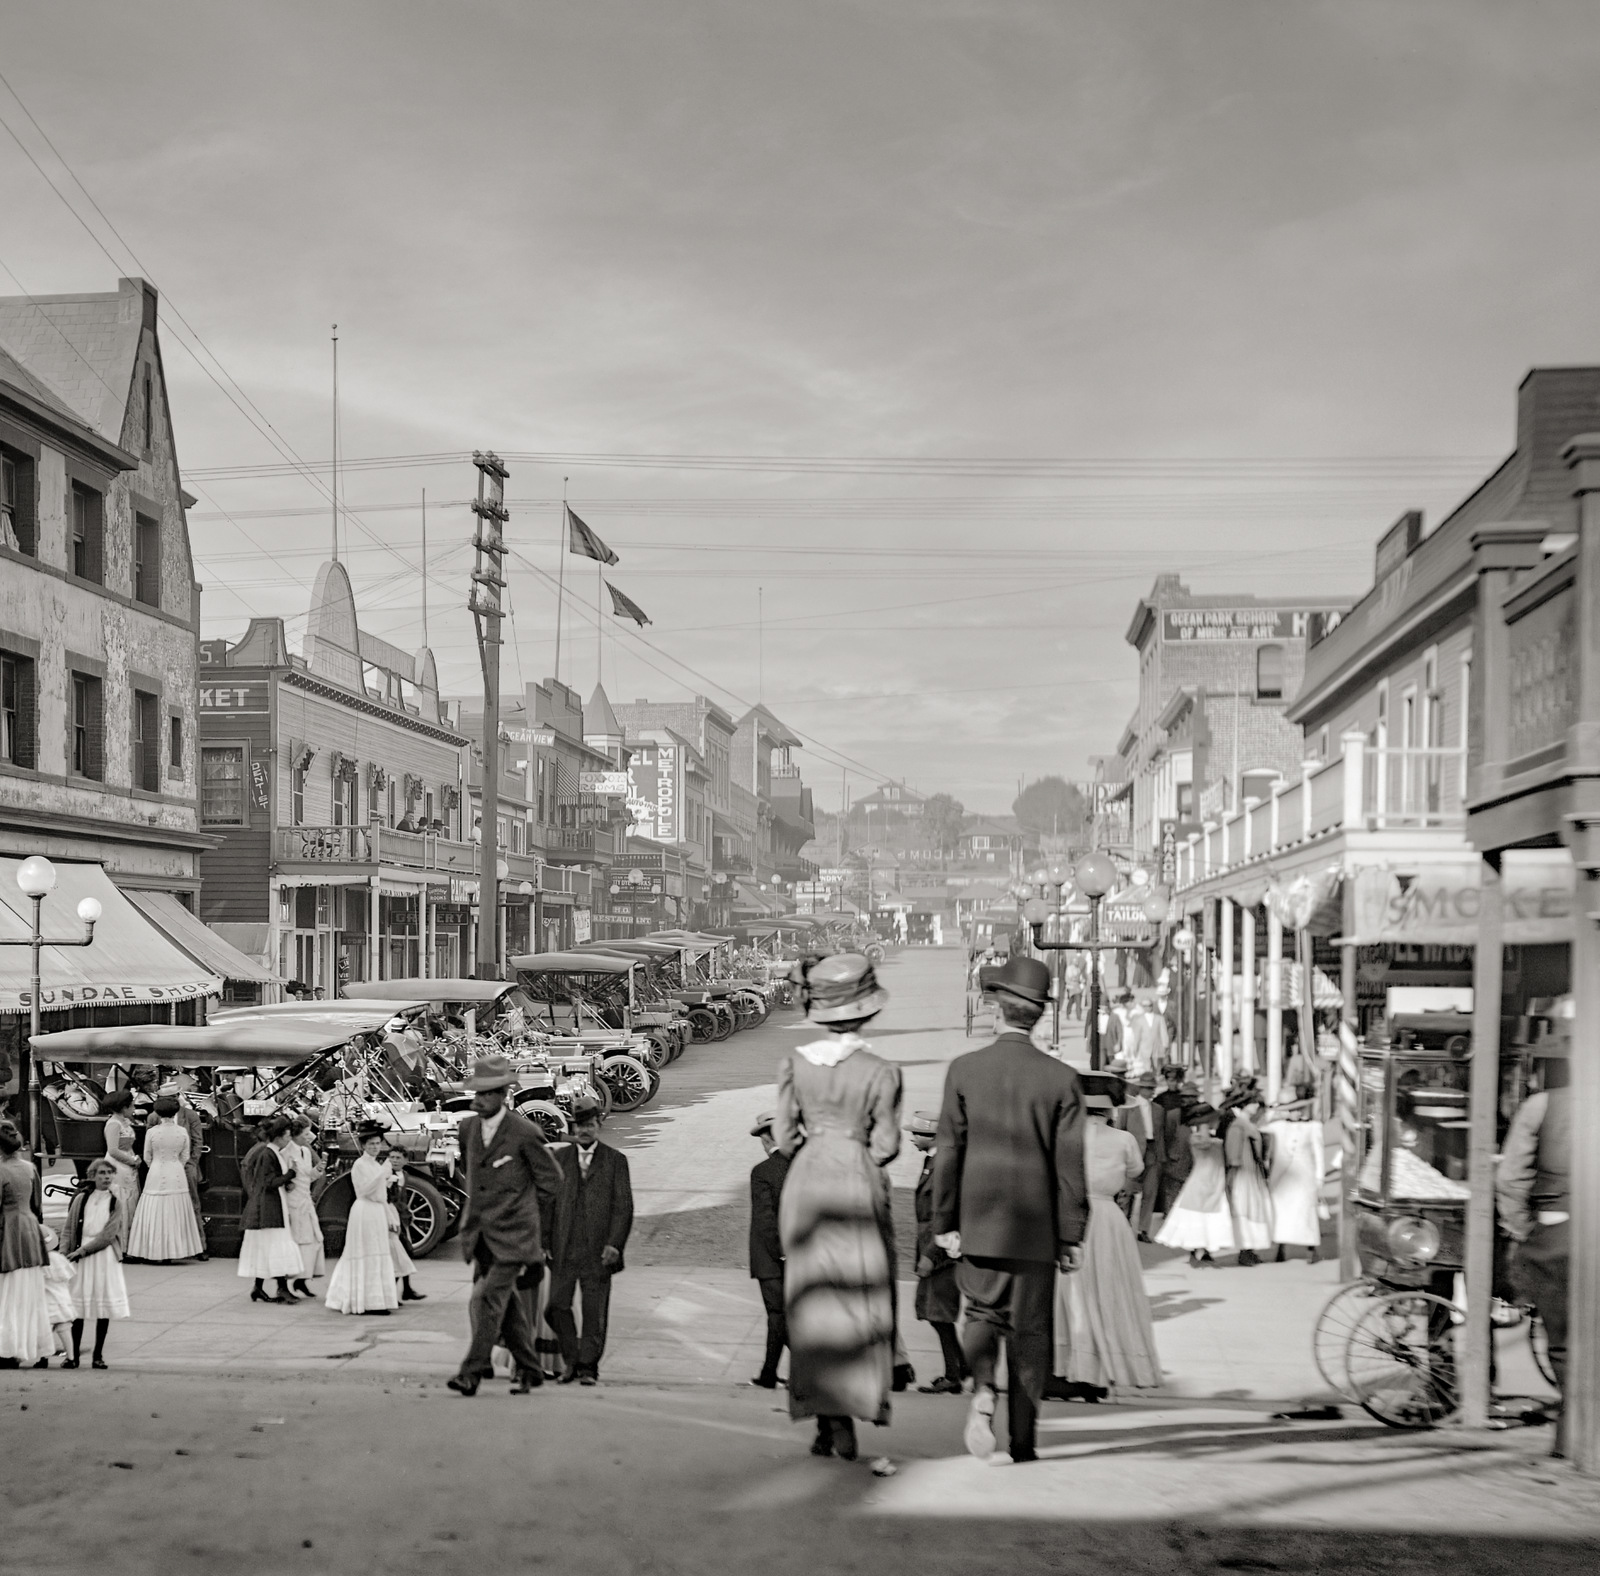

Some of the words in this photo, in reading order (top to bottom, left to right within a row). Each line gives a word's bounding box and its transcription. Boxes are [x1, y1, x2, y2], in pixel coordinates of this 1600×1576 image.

[1170, 612, 1203, 626] OCEAN
[1205, 611, 1233, 625] PARK
[1235, 611, 1280, 625] SCHOOL
[1180, 627, 1194, 639] OF
[1197, 627, 1227, 639] MUSIC
[1252, 627, 1274, 639] ART
[533, 734, 553, 745] VIEW
[251, 762, 269, 810] DENTIST
[580, 783, 625, 792] ROOMS
[657, 748, 674, 836] METROPOLE
[1389, 886, 1569, 923] SMOKE
[395, 913, 463, 923] GRERY
[19, 986, 136, 1007] SUNDAE
[148, 982, 210, 998] SHOP
